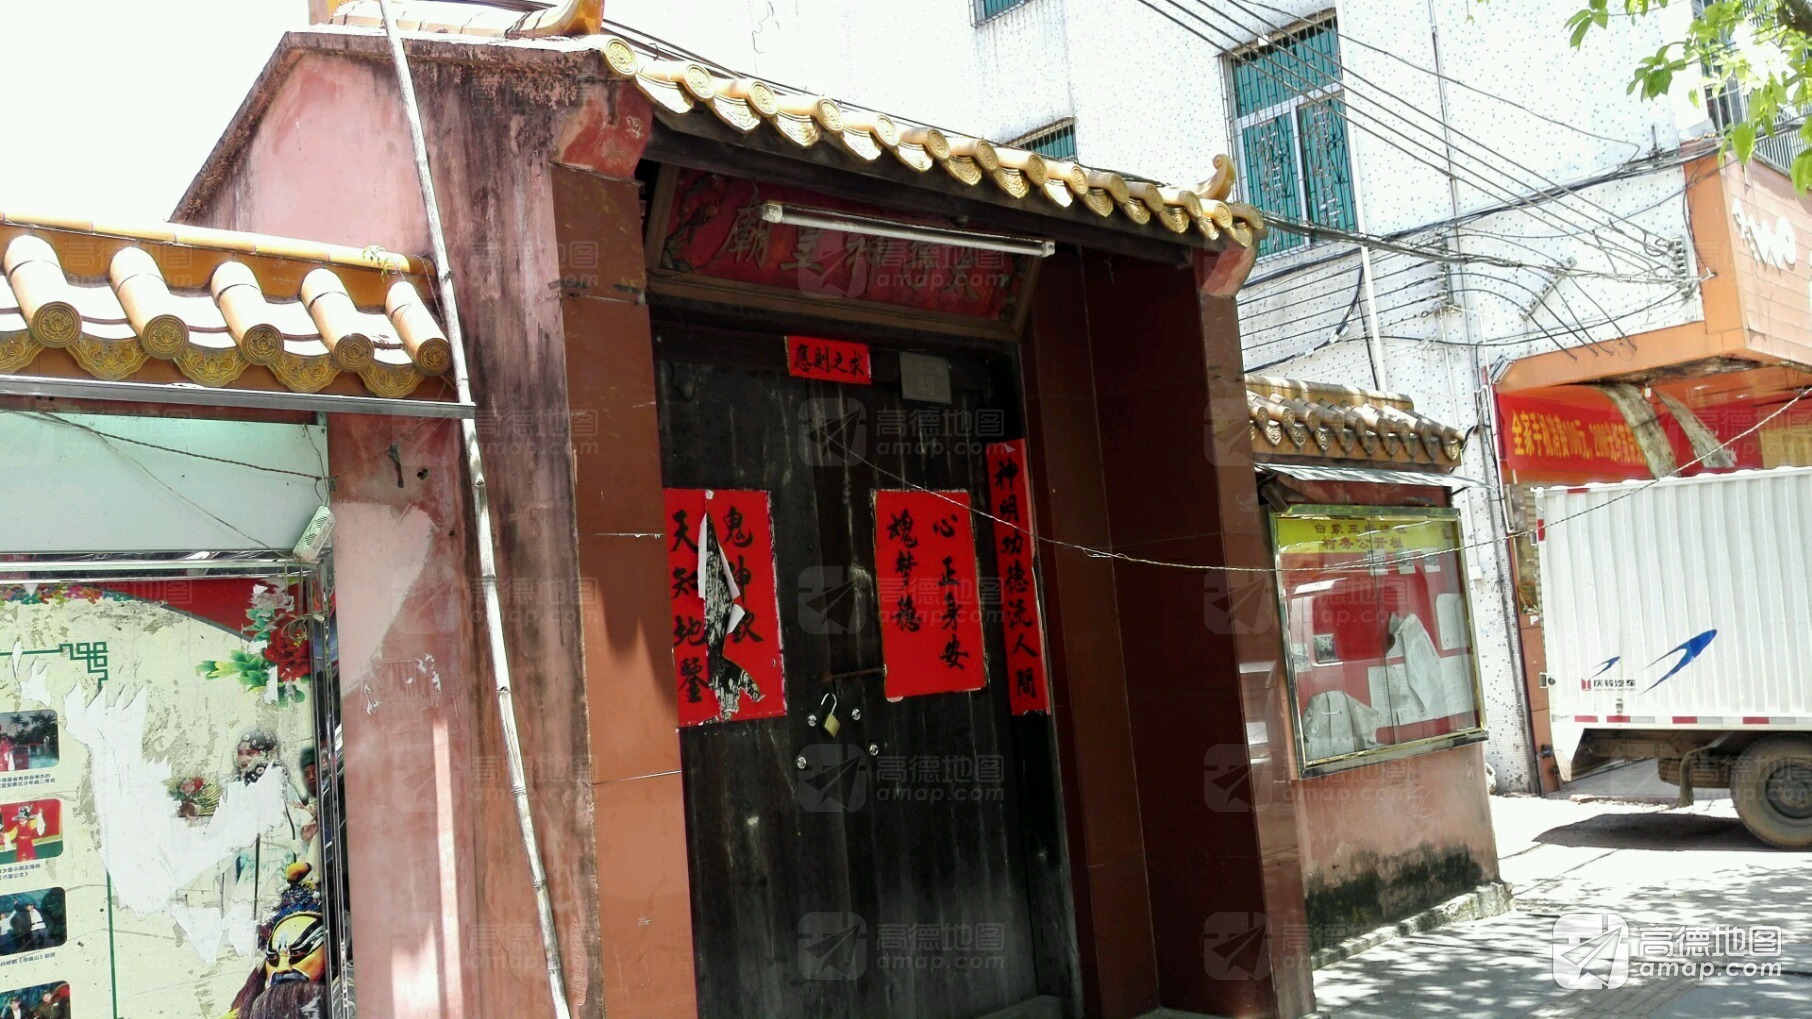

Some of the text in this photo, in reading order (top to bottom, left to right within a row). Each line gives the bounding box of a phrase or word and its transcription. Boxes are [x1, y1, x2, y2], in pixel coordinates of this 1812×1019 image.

[1321, 536, 1404, 550] 村务公开栏
[932, 513, 970, 671] 心正身安
